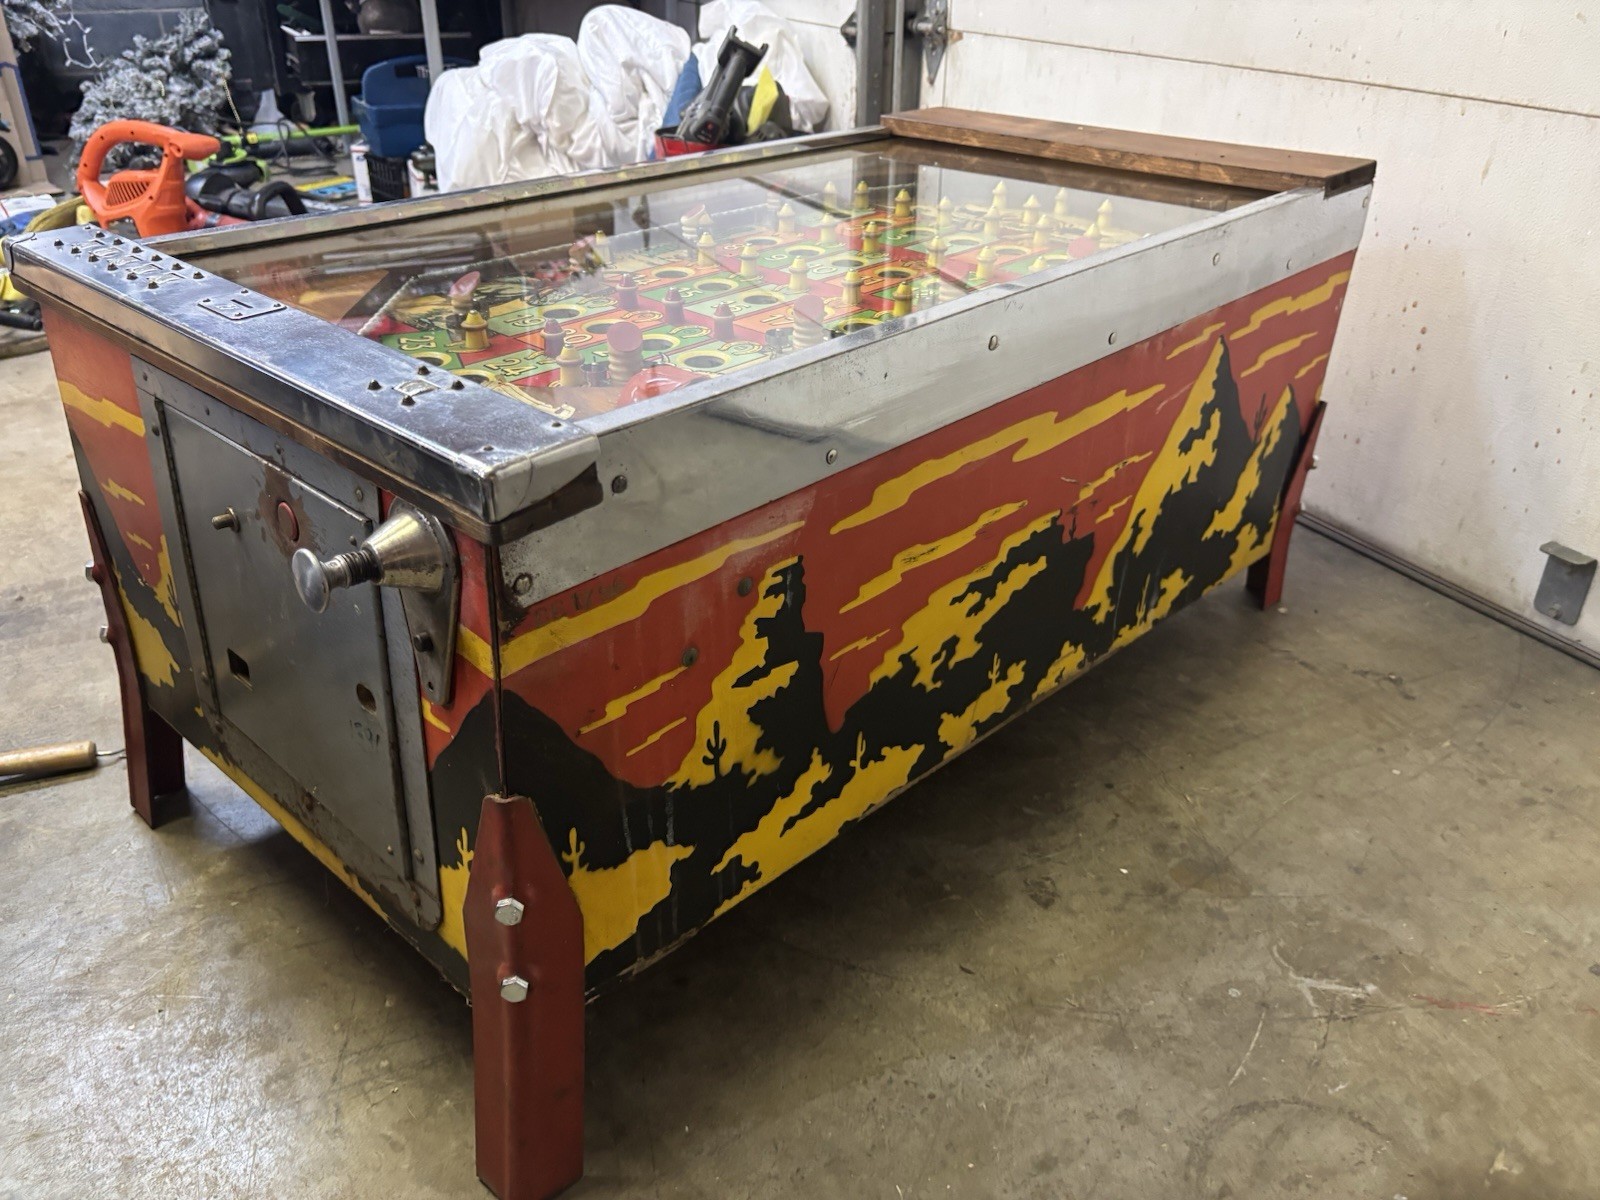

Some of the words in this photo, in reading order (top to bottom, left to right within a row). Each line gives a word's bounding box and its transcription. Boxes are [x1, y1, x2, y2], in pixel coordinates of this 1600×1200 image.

[807, 263, 839, 274] 10
[503, 313, 547, 328] 19
[400, 334, 437, 351] 23
[483, 357, 538, 377] 24
